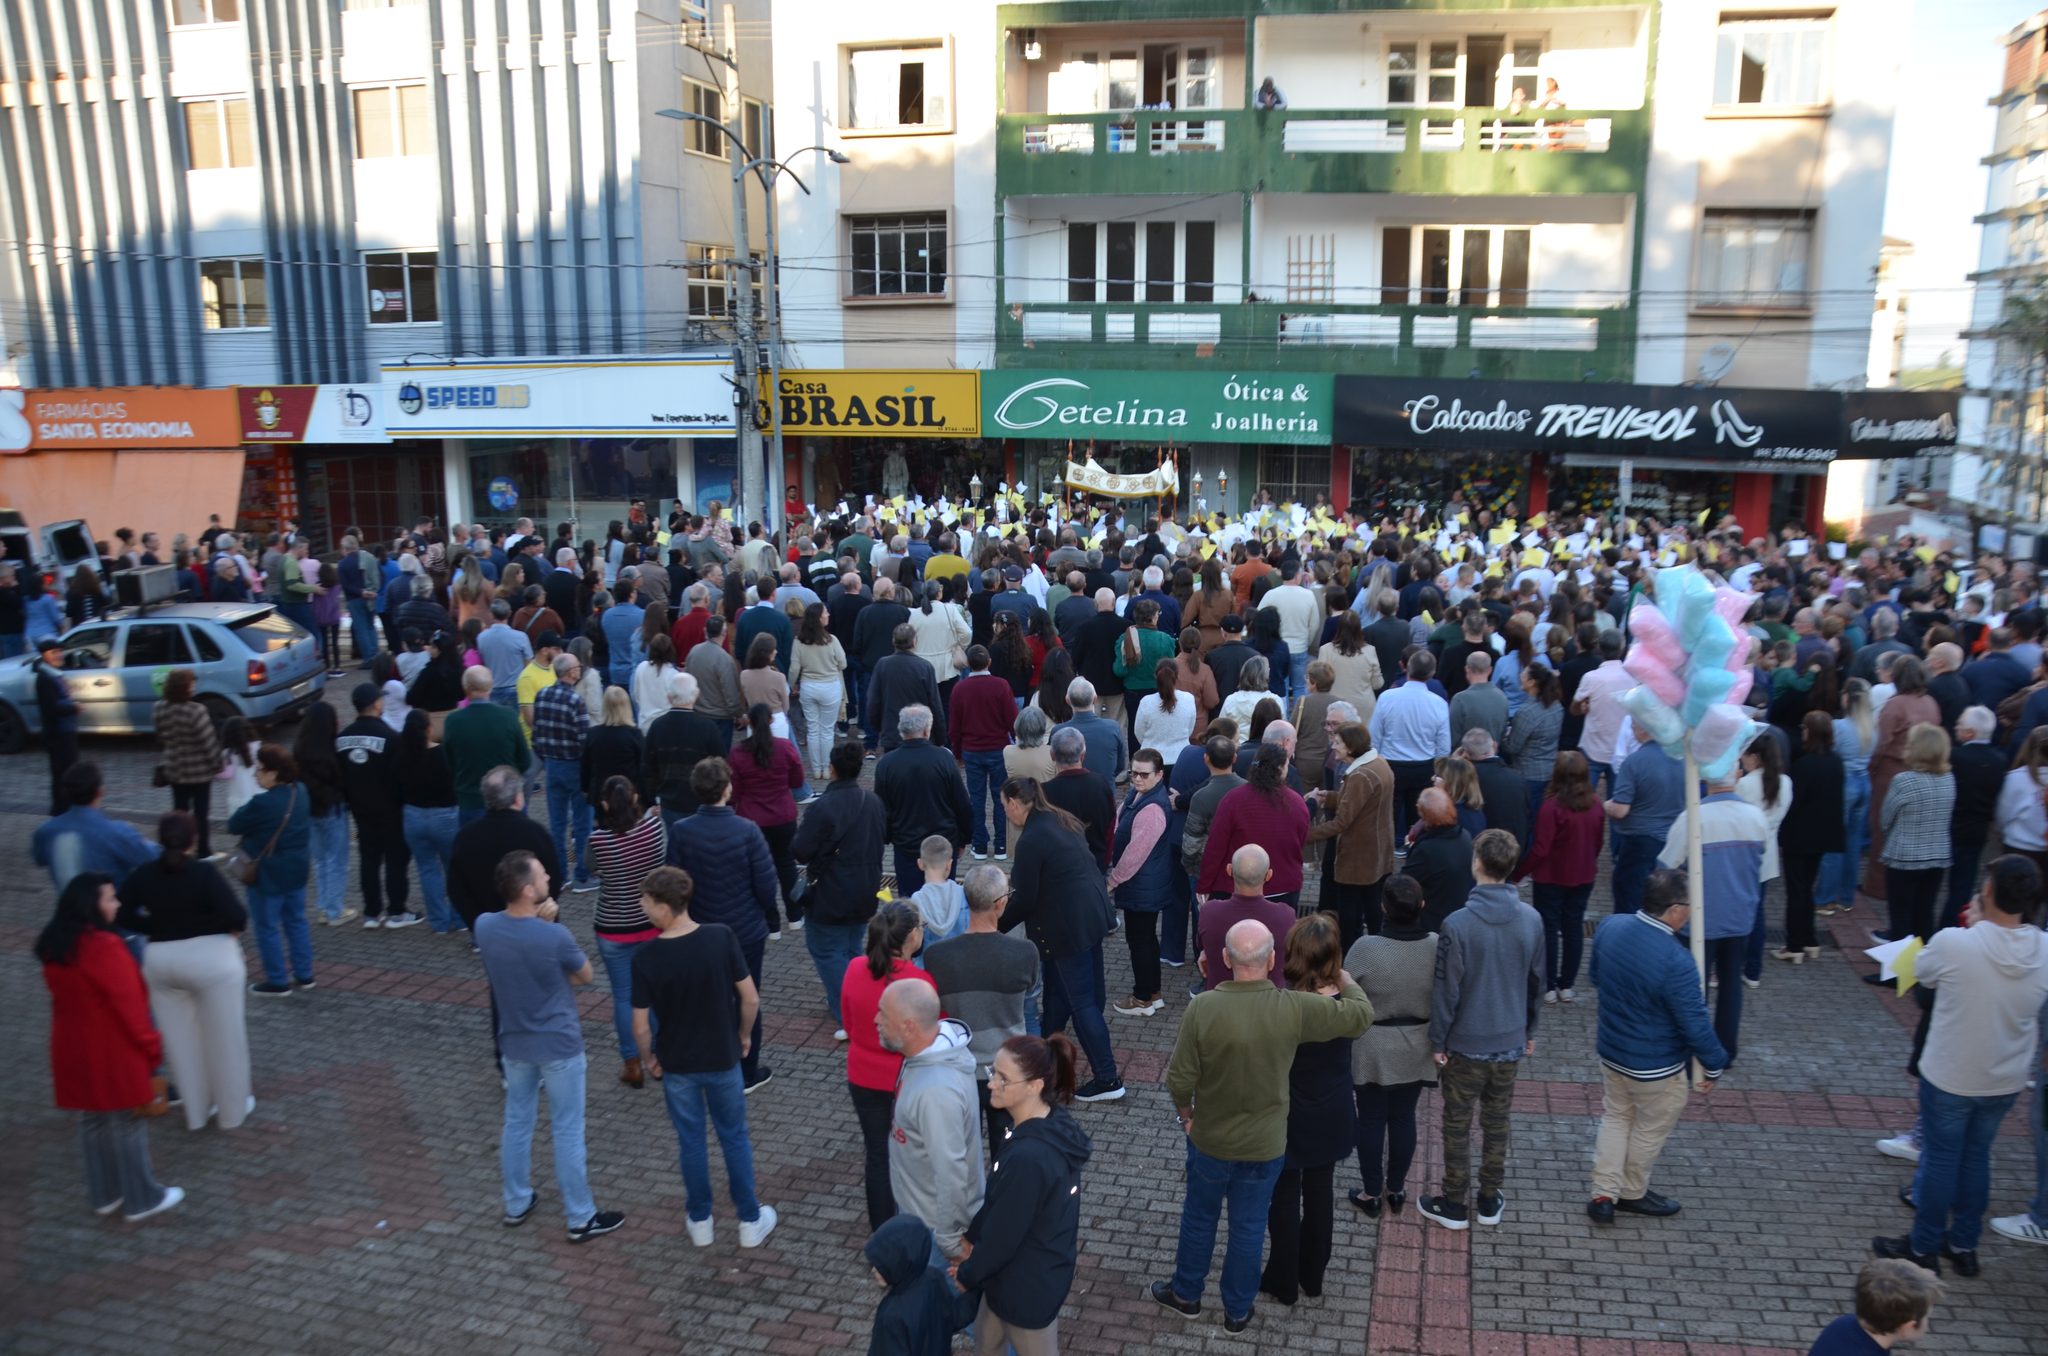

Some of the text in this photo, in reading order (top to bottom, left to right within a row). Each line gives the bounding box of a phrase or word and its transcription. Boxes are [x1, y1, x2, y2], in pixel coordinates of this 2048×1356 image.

[779, 379, 828, 395] Casa
[1223, 375, 1310, 402] Ótica &
[36, 400, 128, 419] FARMÁCIAS
[779, 395, 946, 427] BRASIL
[994, 378, 1189, 430] Getelina
[1211, 411, 1319, 432] Joalheria
[1404, 394, 1699, 442] Calçados TREVISOL
[39, 421, 195, 440] SANTA ECONOMIA
